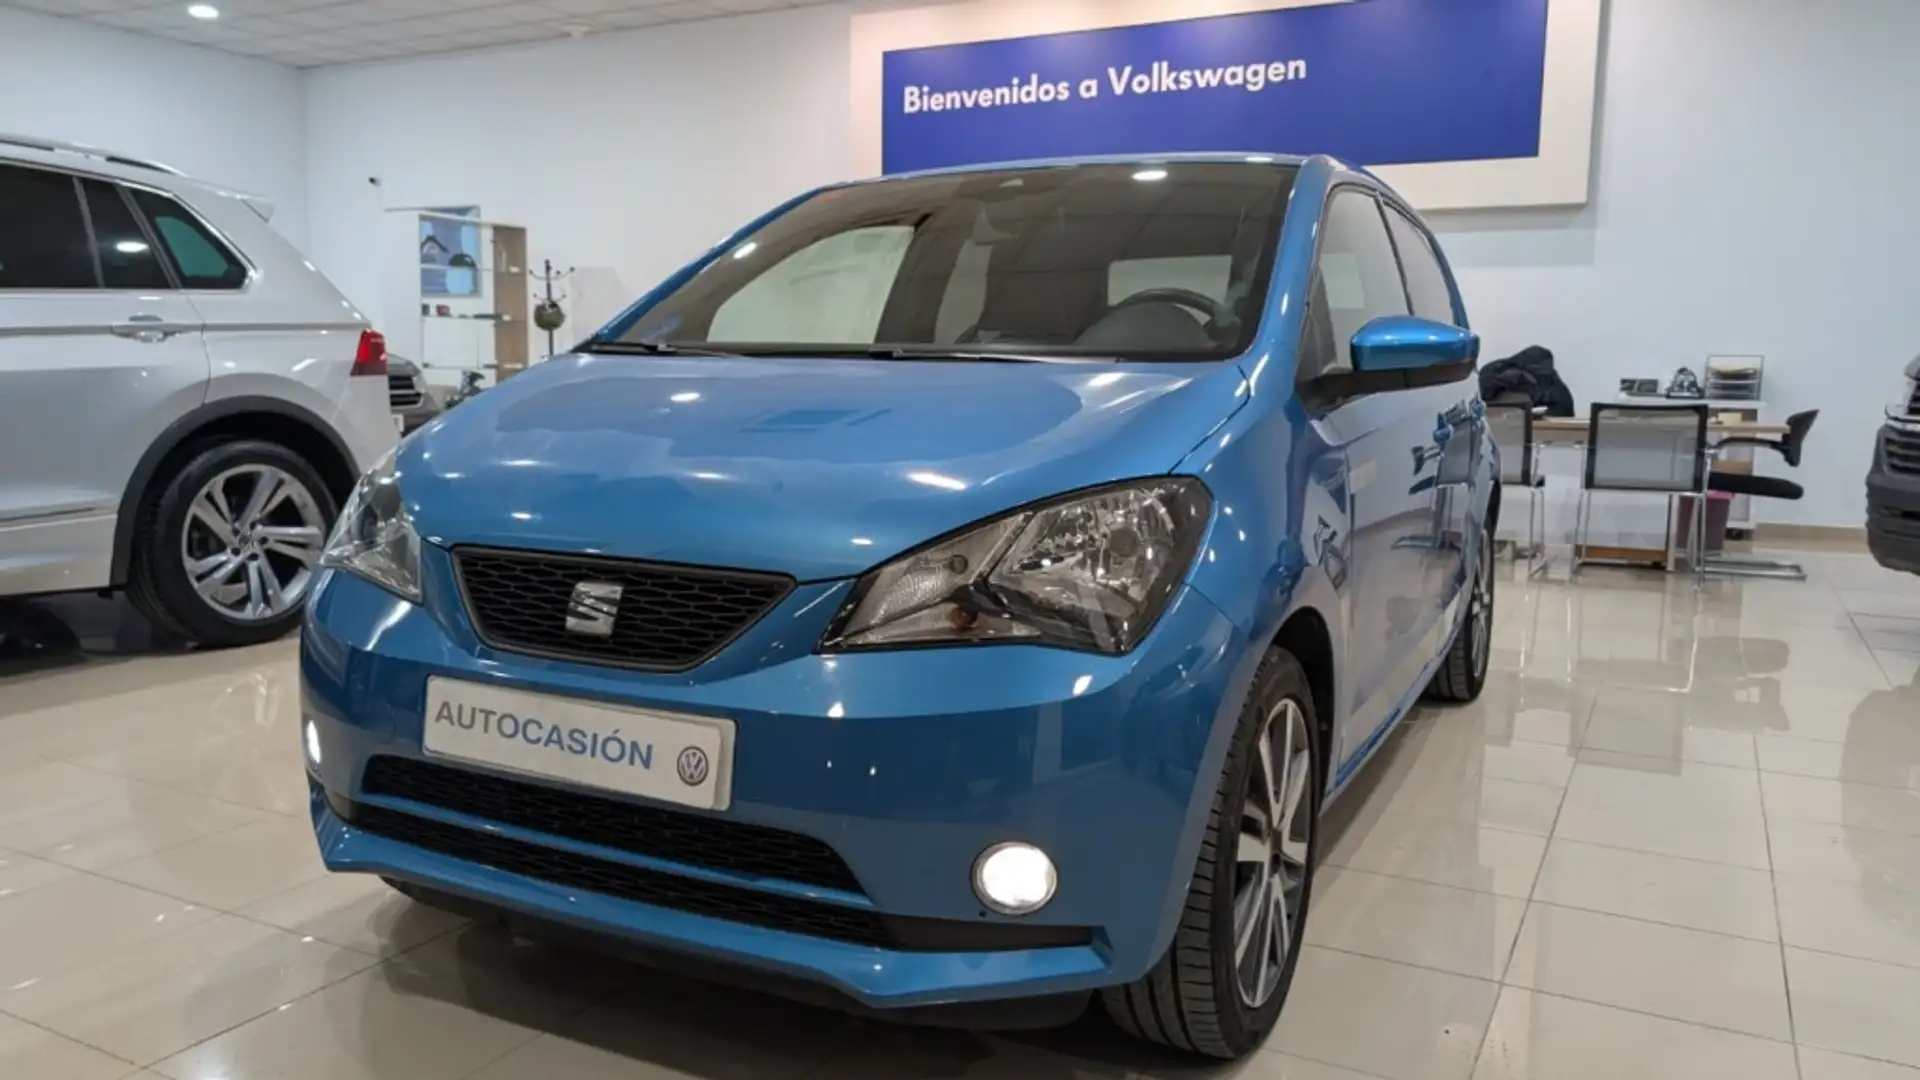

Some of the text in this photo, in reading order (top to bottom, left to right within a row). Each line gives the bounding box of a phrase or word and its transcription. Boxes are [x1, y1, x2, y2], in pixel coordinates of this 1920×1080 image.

[903, 58, 1307, 113] Bienvenidos a Volkswagen
[435, 700, 653, 769] AUTOCASIÓN
